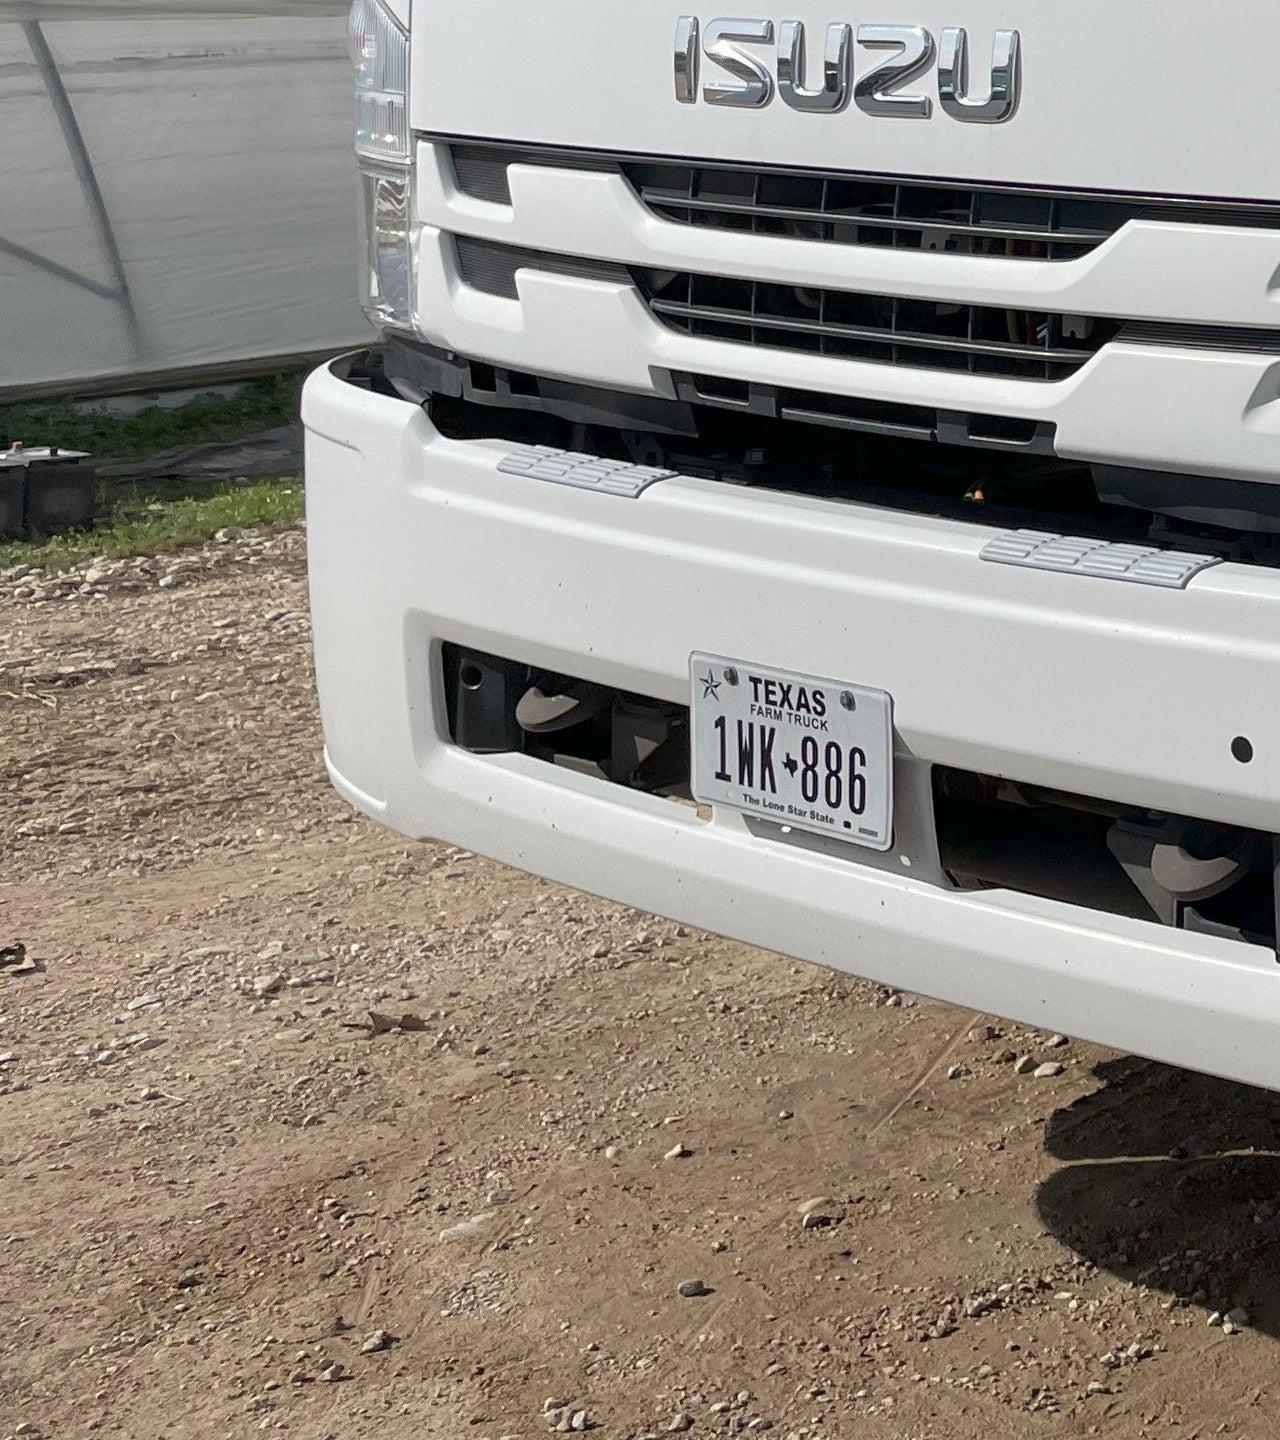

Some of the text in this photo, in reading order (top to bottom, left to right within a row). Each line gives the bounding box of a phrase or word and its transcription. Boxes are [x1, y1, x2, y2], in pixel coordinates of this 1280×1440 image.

[673, 14, 1022, 125] ISUZU
[748, 676, 827, 717] TEXAS
[750, 704, 829, 732] FARM TRUCK
[742, 792, 836, 824] The Lone Star State
